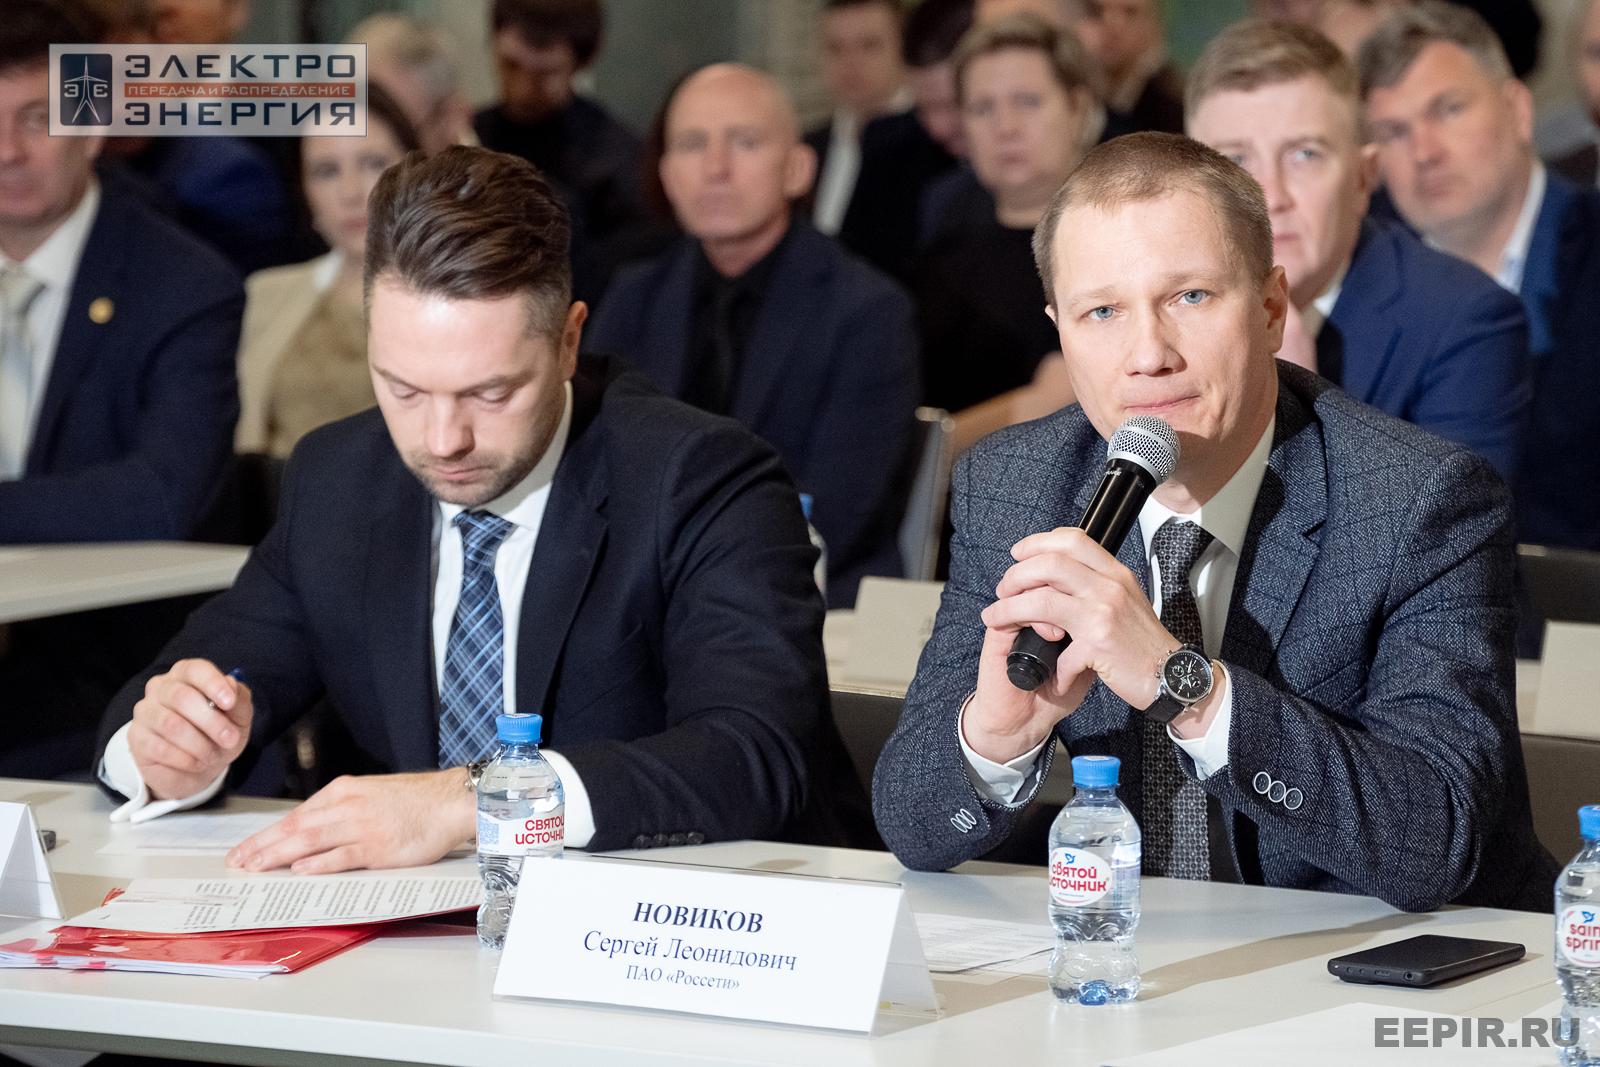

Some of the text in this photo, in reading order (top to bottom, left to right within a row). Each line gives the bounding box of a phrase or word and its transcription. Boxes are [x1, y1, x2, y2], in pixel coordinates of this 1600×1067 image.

[632, 902, 763, 933] НОВИКОВ
[584, 930, 798, 971] Сергей Леонидович
[626, 964, 741, 990] ПАО «Россети»
